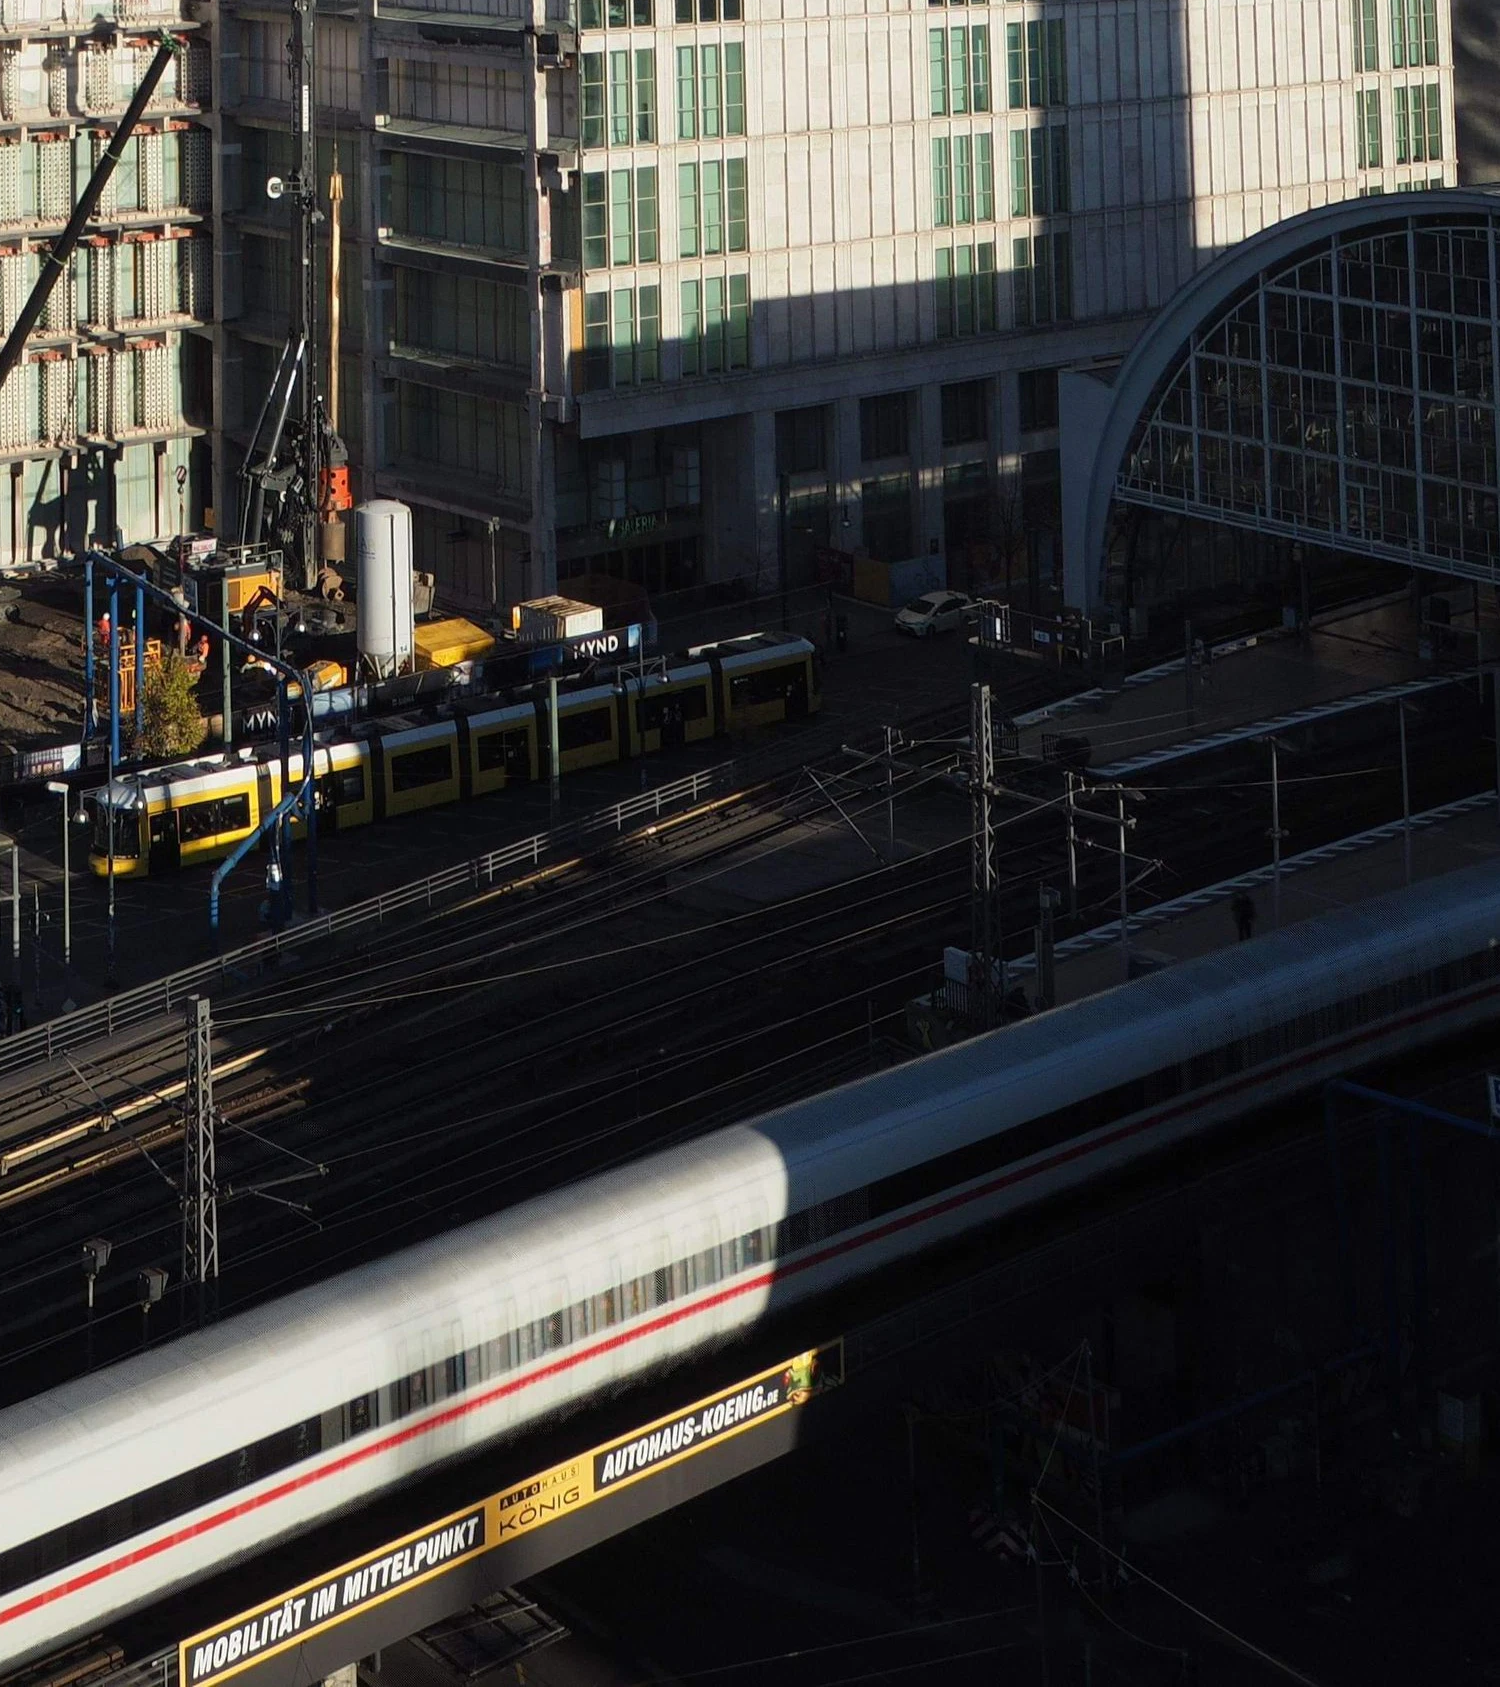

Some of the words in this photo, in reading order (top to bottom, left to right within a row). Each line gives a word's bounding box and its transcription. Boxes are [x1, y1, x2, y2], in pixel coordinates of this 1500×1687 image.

[573, 635, 619, 659] MYND
[601, 1385, 779, 1483] AUTOHAUS-KOENIG.DE
[500, 1463, 580, 1511] AUTOHAUS
[500, 1485, 580, 1538] KÖNIG
[192, 1597, 306, 1680] MOBILITÄT
[311, 1585, 337, 1618] IM
[342, 1515, 480, 1610] MITTELPUNKT
